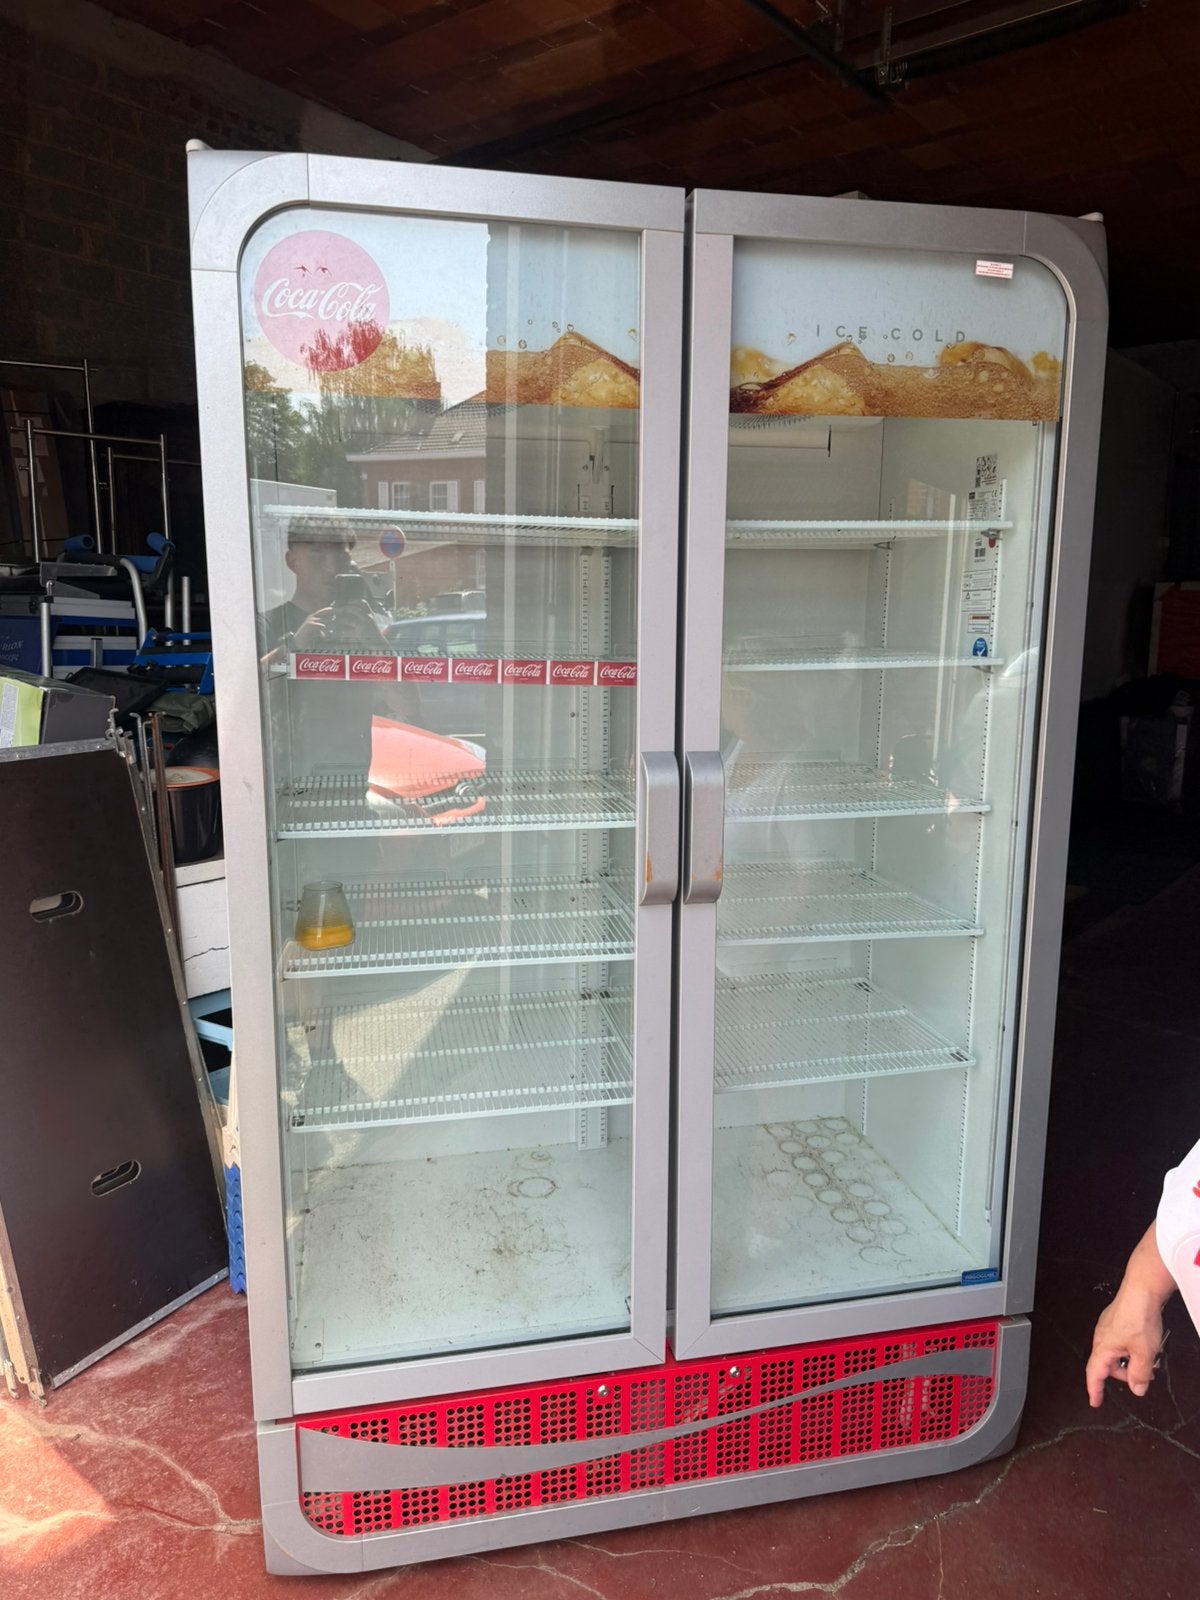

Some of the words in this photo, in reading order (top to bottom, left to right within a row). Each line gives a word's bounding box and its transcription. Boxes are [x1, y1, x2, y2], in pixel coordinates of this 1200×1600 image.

[261, 278, 383, 321] Coca-Cola
[816, 324, 868, 340] ICE
[890, 328, 966, 343] COLD
